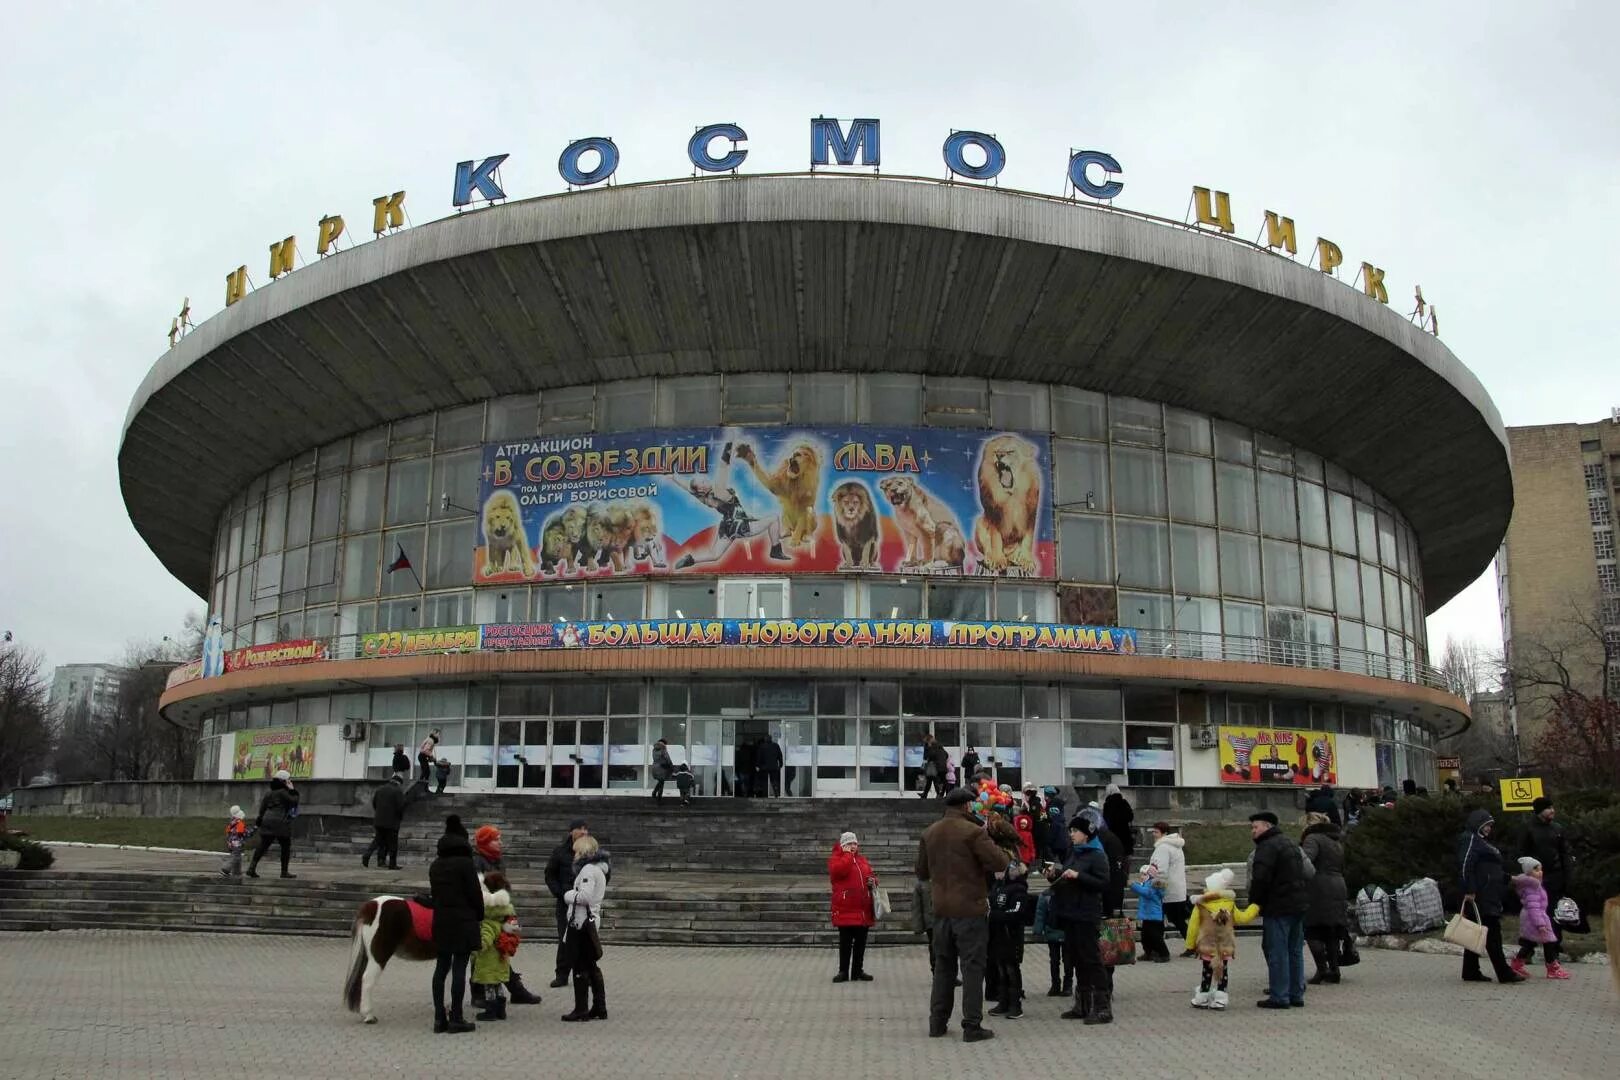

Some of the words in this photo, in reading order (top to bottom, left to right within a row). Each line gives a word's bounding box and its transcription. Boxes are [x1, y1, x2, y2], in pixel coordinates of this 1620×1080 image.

[452, 117, 1123, 206] КОСМОС
[1193, 185, 1389, 304] ЦИРК
[495, 437, 593, 457] АТТРАКЦИОН
[494, 460, 512, 486] В
[524, 446, 707, 482] СОЗВЕЗДИИ
[833, 442, 920, 472] ЛЬВА
[520, 494, 563, 506] ОЛЬГИ
[570, 484, 658, 502] БОРИСОВОЙ
[378, 632, 402, 655] 23
[404, 631, 477, 653] ДЕКАБРЯ
[587, 622, 724, 645] БОЛЬШАЯ
[739, 622, 932, 646] НОВОГОДНЯЯ
[948, 622, 1115, 650] ПРОГРАММА
